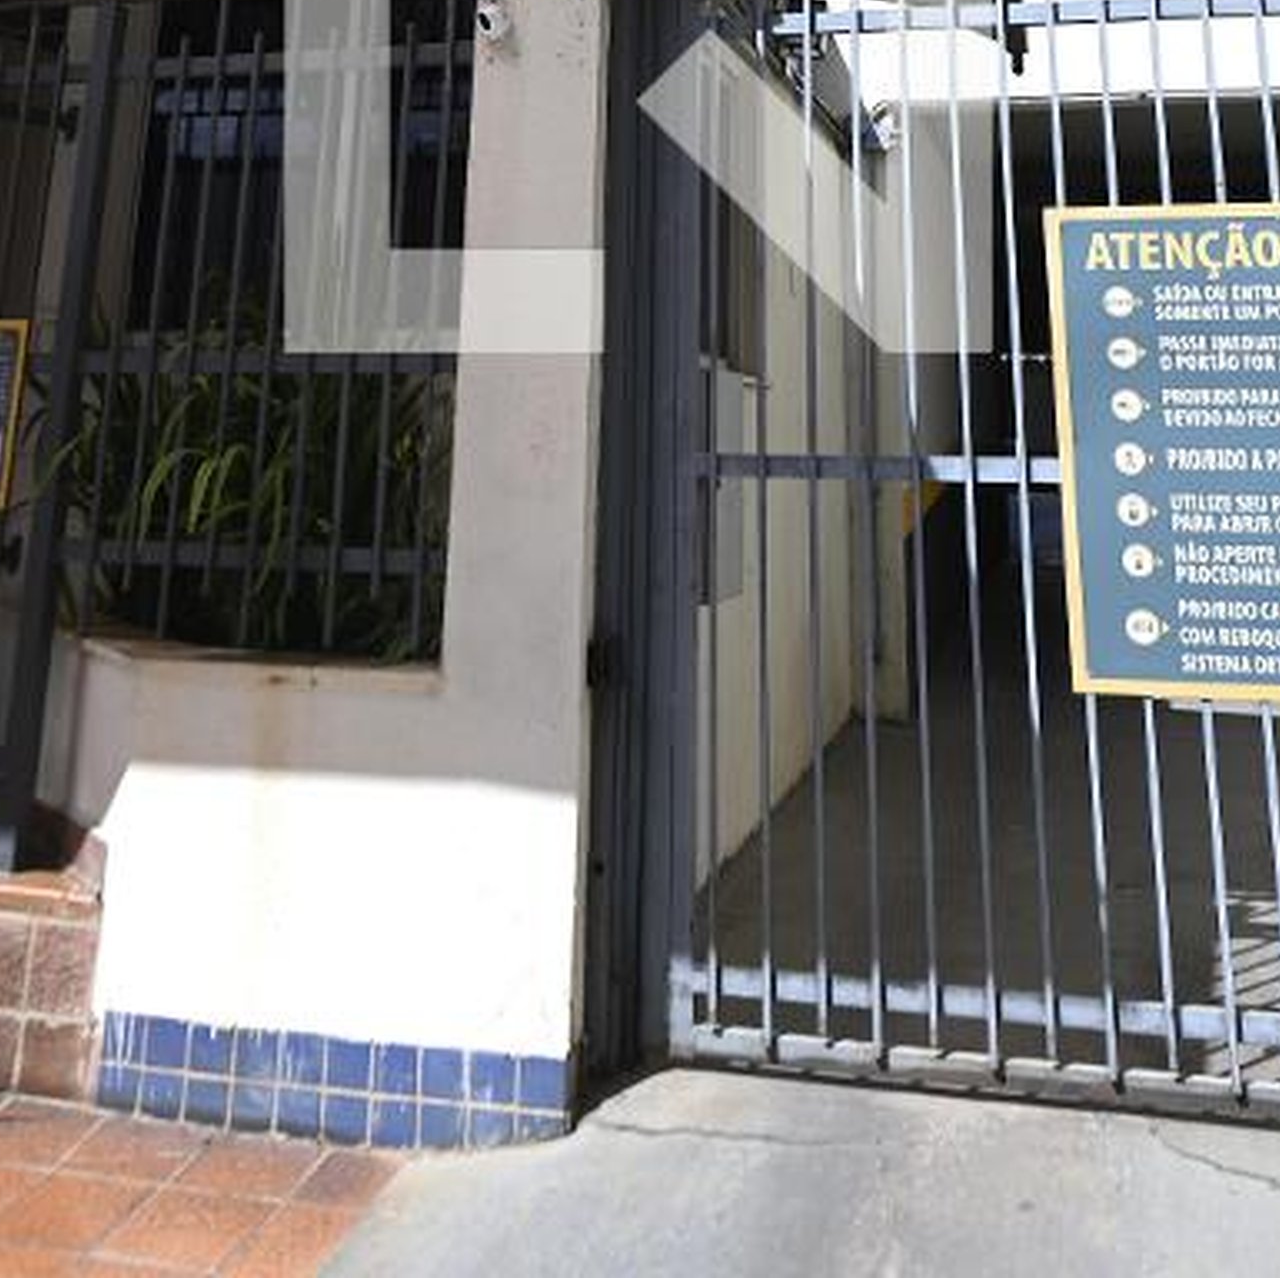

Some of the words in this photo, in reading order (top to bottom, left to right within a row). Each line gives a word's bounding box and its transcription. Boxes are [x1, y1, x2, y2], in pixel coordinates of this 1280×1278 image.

[1152, 282, 1203, 302] SAÍDA
[1158, 354, 1173, 371] O
[1175, 351, 1240, 371] PORTÃO
[1161, 388, 1238, 406] PROIBIDO
[1163, 409, 1221, 427] DEVIDO
[1223, 409, 1247, 427] AO
[1167, 448, 1248, 471] PROIBIDO
[1251, 449, 1263, 471] A
[1170, 494, 1233, 513] UTILIZE
[1234, 494, 1269, 513] SEU
[1172, 514, 1216, 533] PARA
[1218, 515, 1272, 533] ABRIR
[1174, 540, 1210, 564] NÃO
[1212, 545, 1277, 565] APERTE
[1178, 599, 1258, 621] PROIBIDO
[1179, 626, 1216, 644] COM
[1181, 653, 1252, 674] SISTEMA
